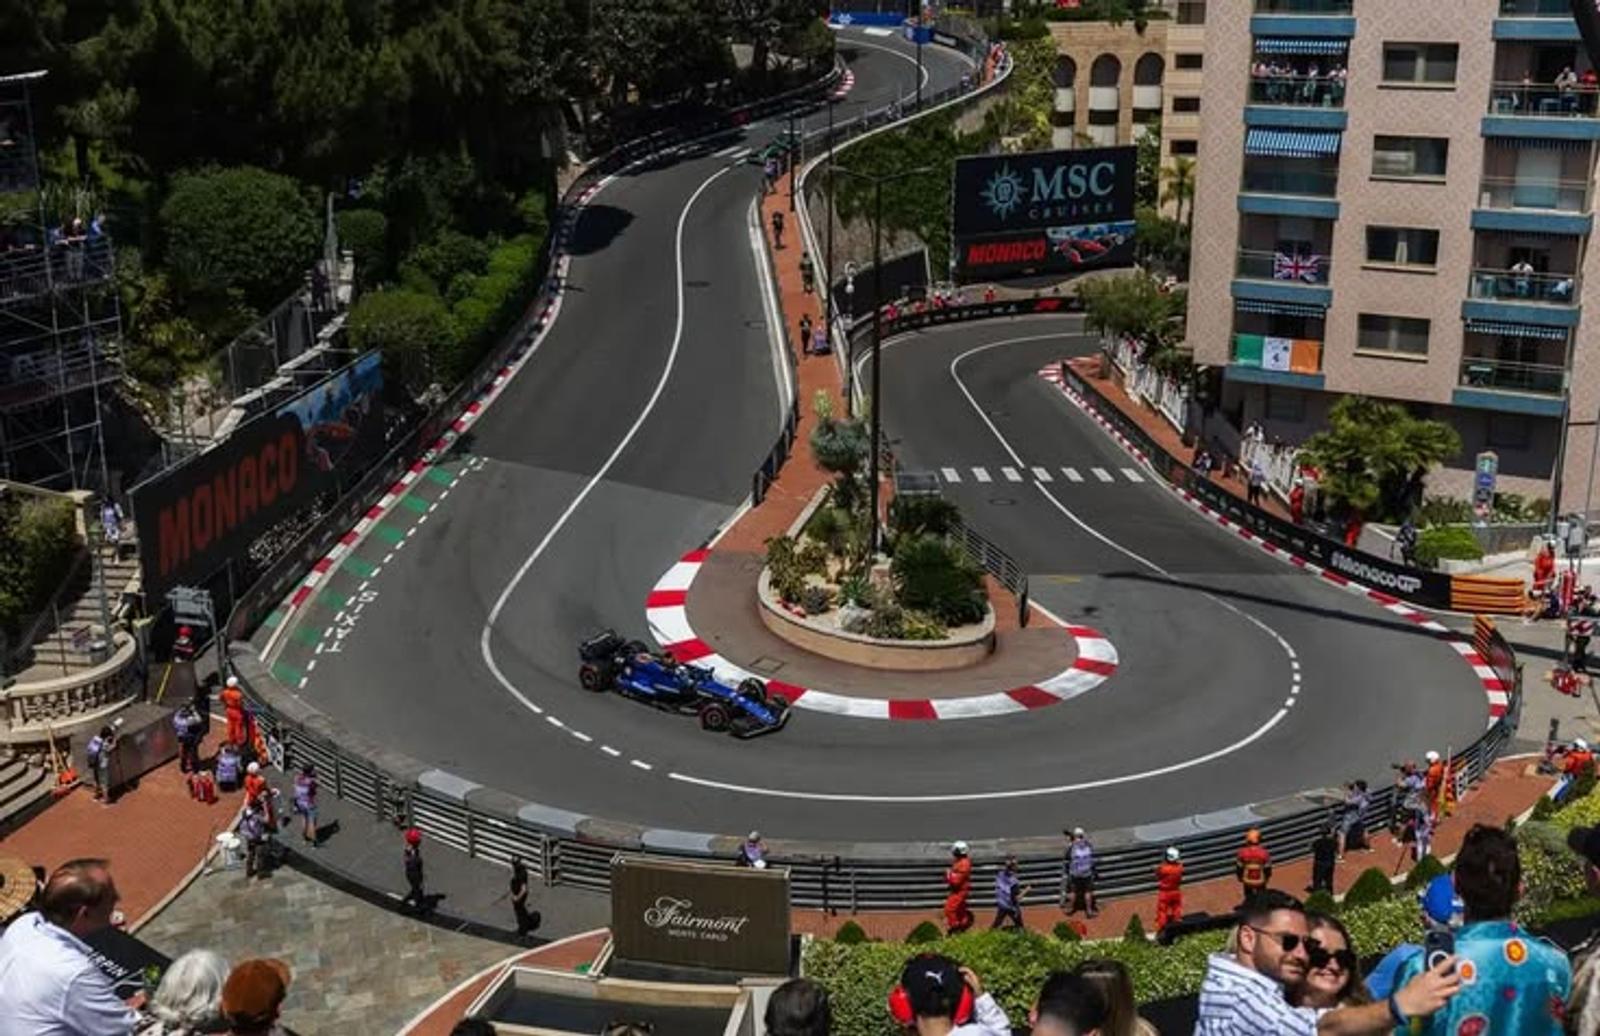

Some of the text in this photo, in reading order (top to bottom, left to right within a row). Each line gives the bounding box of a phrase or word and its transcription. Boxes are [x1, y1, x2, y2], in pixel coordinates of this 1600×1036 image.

[1031, 162, 1115, 202] MSC
[968, 240, 1046, 265] MONACO
[159, 431, 298, 577] MONACO
[644, 896, 749, 935] Fairmont
[668, 928, 728, 942] MONTE CARLO
